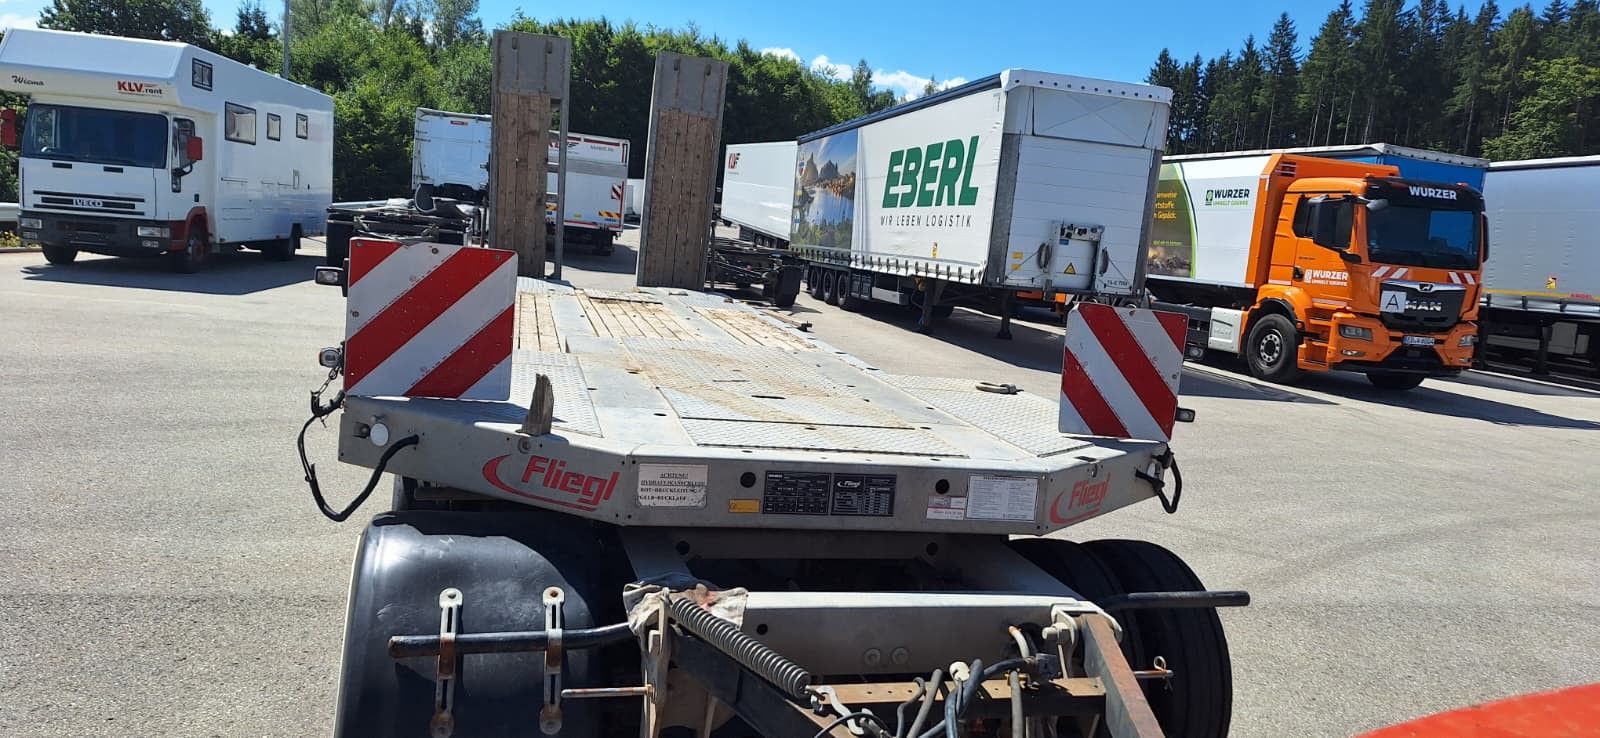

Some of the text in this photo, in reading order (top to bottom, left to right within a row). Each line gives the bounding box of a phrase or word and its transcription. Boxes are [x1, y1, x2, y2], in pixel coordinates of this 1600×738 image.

[882, 135, 980, 208] EBERL
[1214, 189, 1250, 199] WURZER
[1408, 186, 1457, 200] WURZER
[73, 199, 103, 208] IVECO
[880, 214, 972, 227] WIR LEBEN LOGISTIK
[1312, 270, 1349, 281] WURZER
[1385, 294, 1399, 310] A
[1405, 300, 1442, 311] MAN
[521, 455, 620, 506] Fliegl
[1067, 472, 1111, 511] Fliegl
